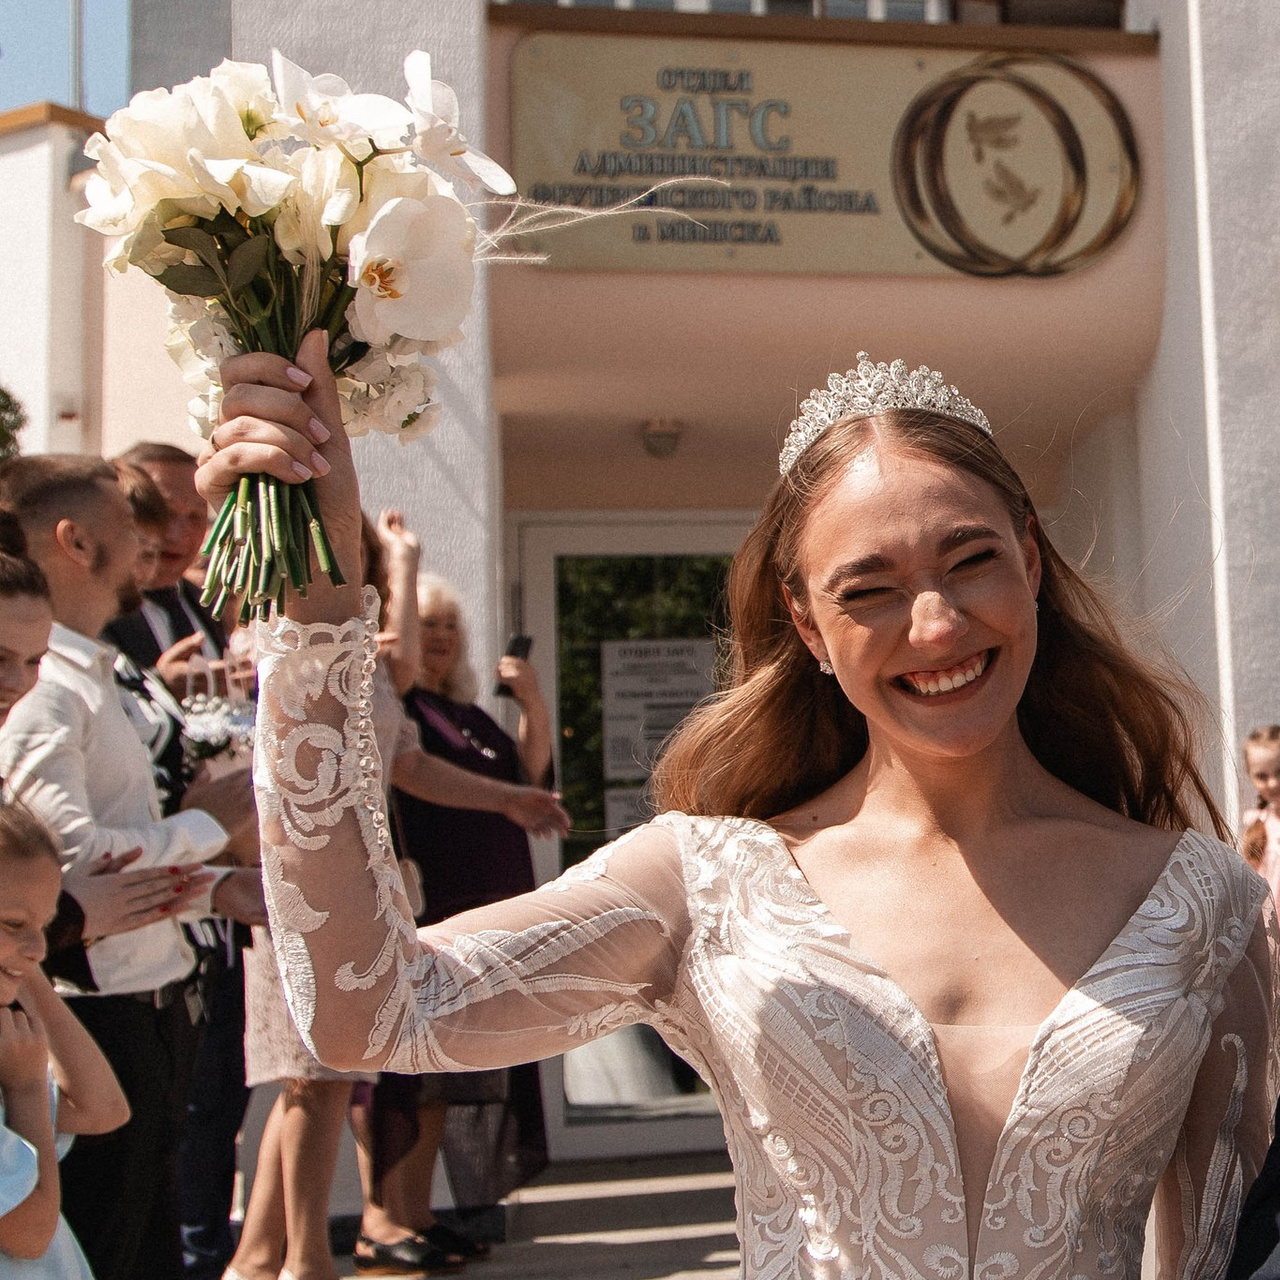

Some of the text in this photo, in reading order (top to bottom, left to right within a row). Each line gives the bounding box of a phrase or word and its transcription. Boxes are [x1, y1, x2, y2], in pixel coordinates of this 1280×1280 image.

[620, 96, 791, 151] ЗАГС
[574, 151, 836, 180] АДМИНИСТРАЦИИ
[764, 185, 879, 213] РАЙОНА
